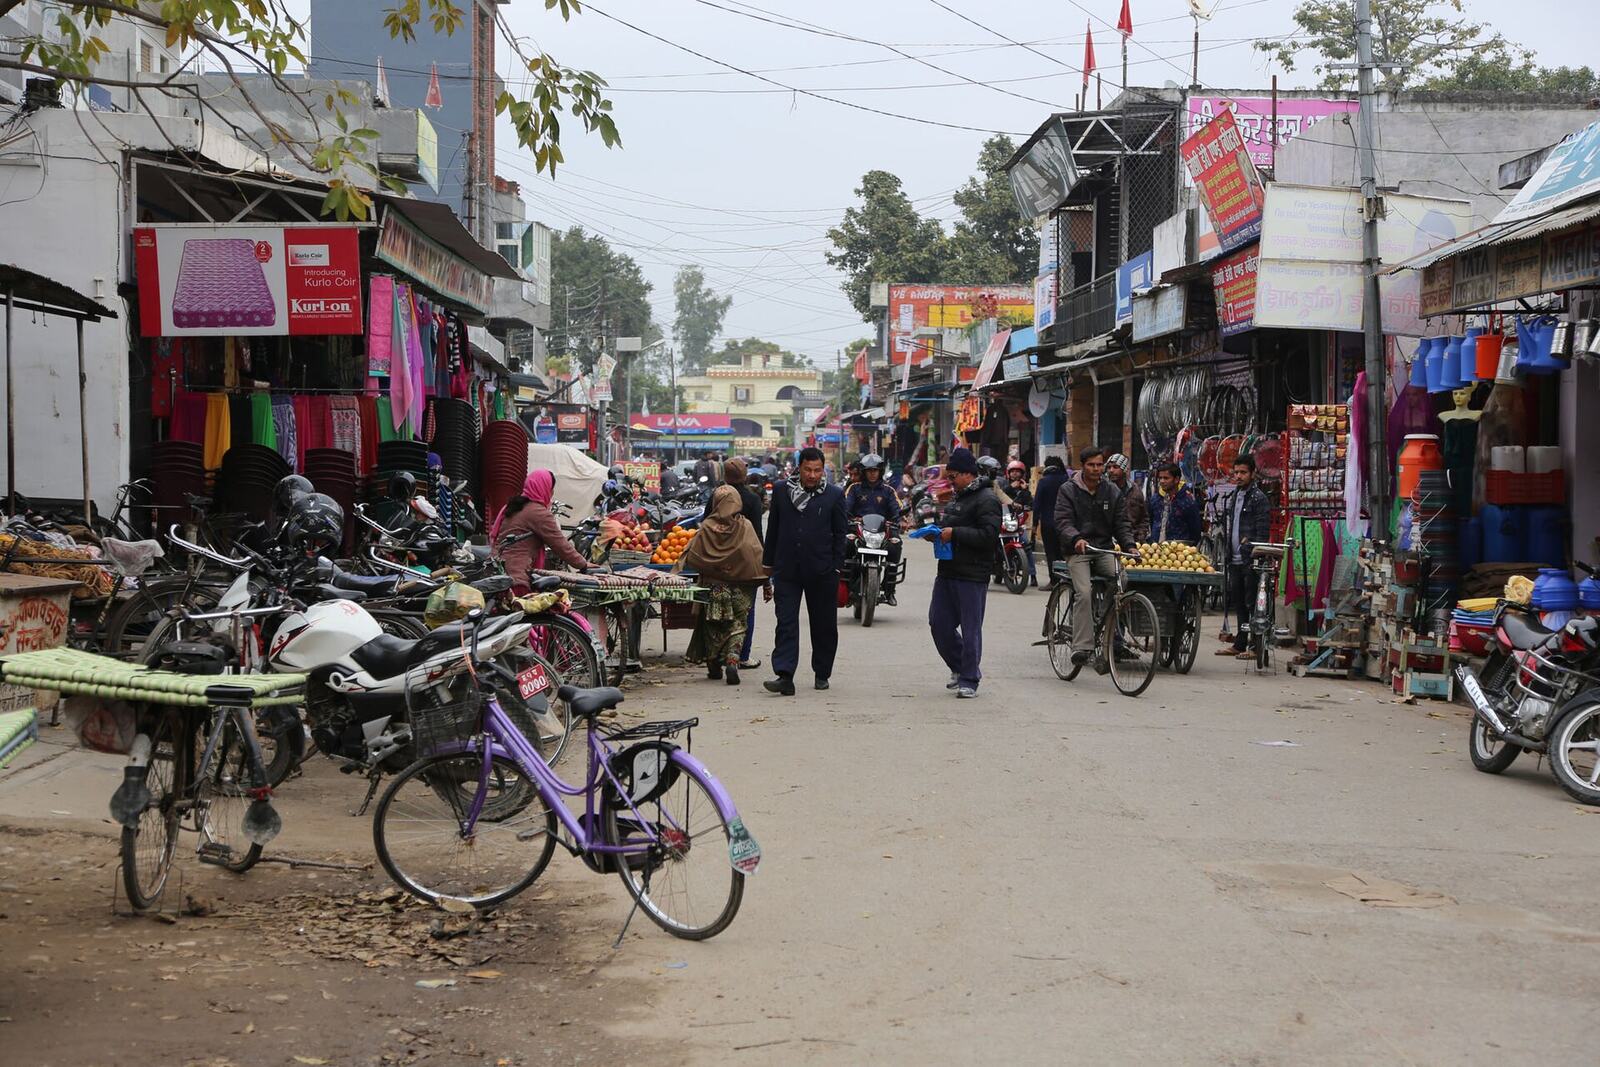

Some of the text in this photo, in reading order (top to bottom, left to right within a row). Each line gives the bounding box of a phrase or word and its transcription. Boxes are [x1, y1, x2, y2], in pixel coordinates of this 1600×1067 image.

[260, 244, 266, 252] 2
[304, 269, 346, 277] Introducing
[304, 277, 356, 287] Kurlo Coir
[290, 298, 350, 313] Kurl-on
[656, 416, 702, 427] LAVA
